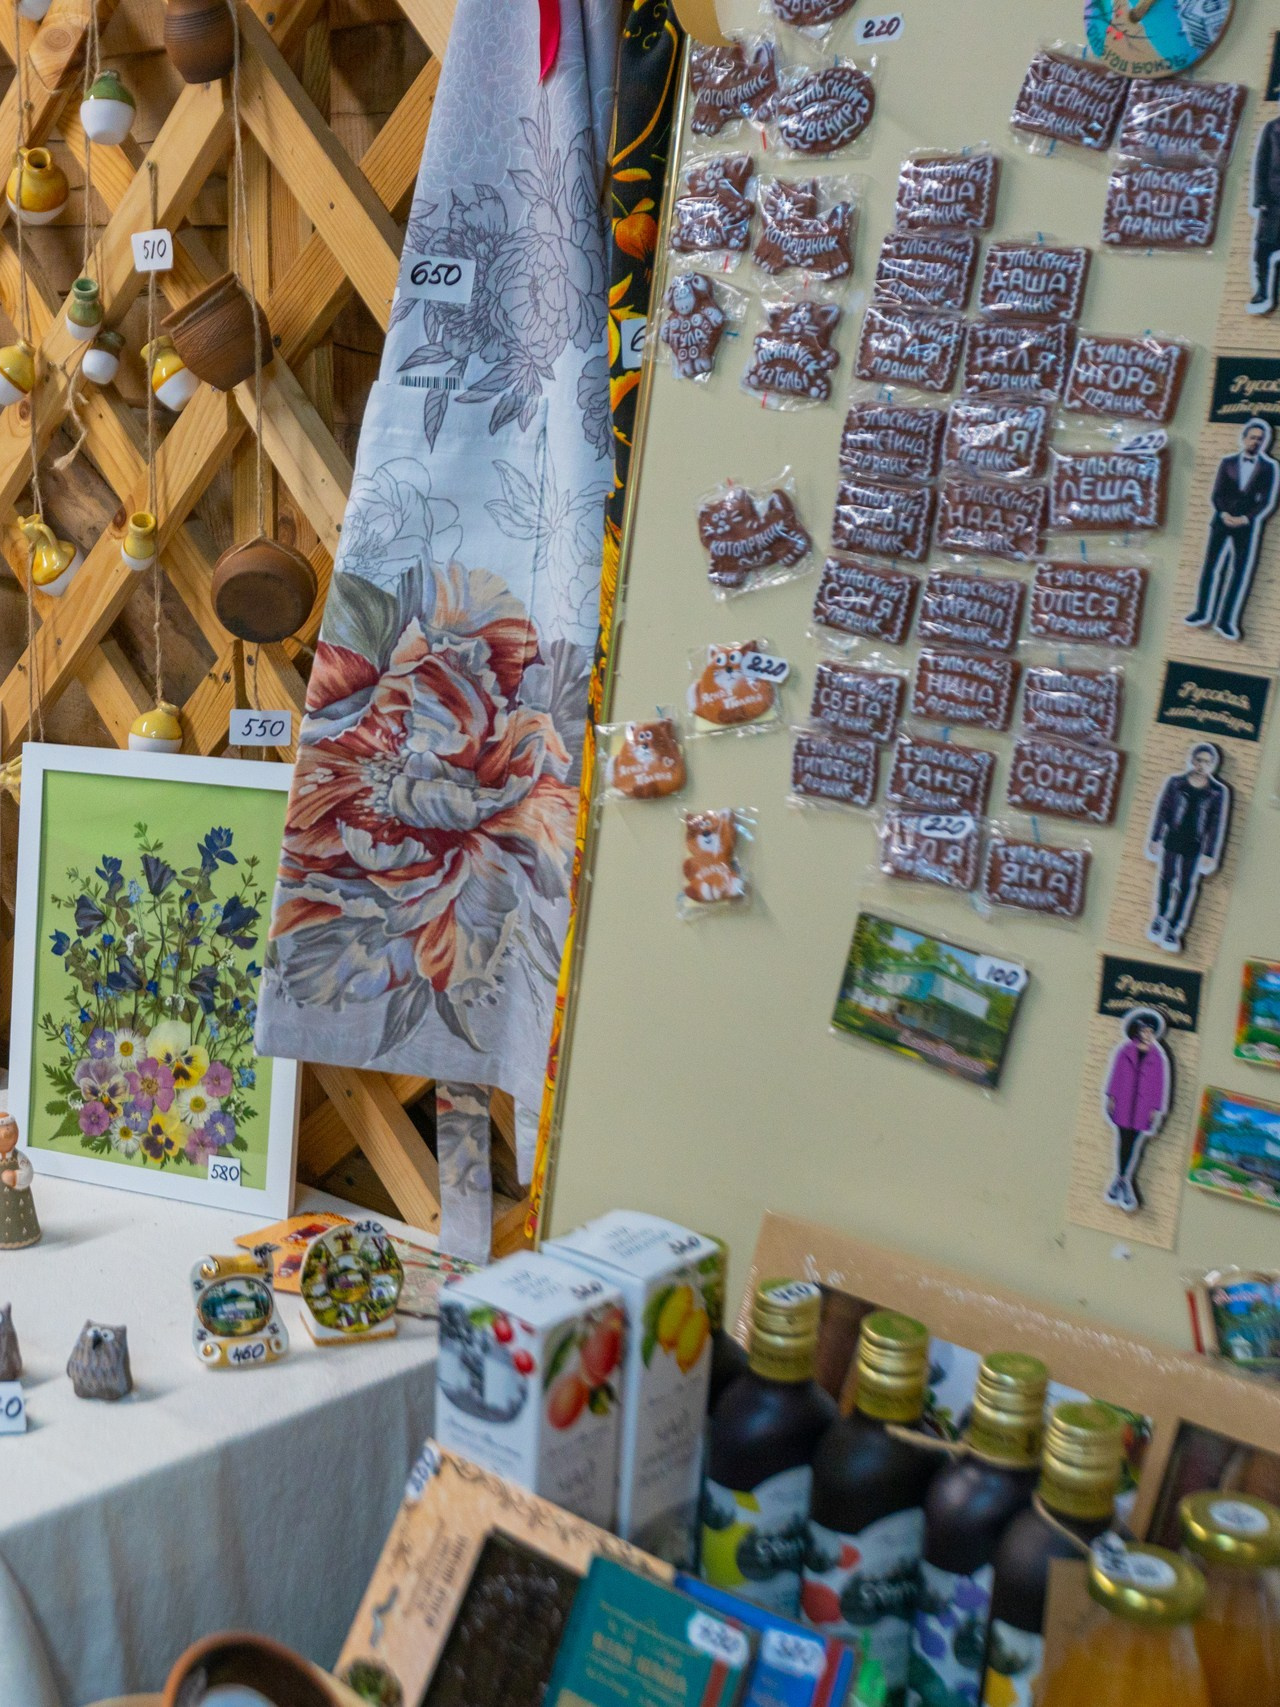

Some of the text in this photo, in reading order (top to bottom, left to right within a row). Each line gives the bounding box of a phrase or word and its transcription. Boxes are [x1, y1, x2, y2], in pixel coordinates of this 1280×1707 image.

[863, 17, 900, 38] 220
[1111, 191, 1199, 217] ДАША
[143, 238, 167, 260] 510
[410, 260, 462, 286] 650
[988, 268, 1067, 293] ДАША
[670, 328, 707, 348] ТУЛА
[974, 346, 1057, 372] ГАЛЯ
[1078, 363, 1157, 395] ИГОРЬ
[1061, 476, 1143, 503] ЛЕША
[946, 504, 1029, 536] НАДЯ
[746, 655, 788, 677] 220
[241, 718, 285, 737] 550
[899, 762, 974, 796] ТАНЯ
[1017, 760, 1100, 797] СОНЯ
[1000, 861, 1068, 895] ЯНА
[985, 964, 1020, 987] 100
[210, 1164, 240, 1181] 580
